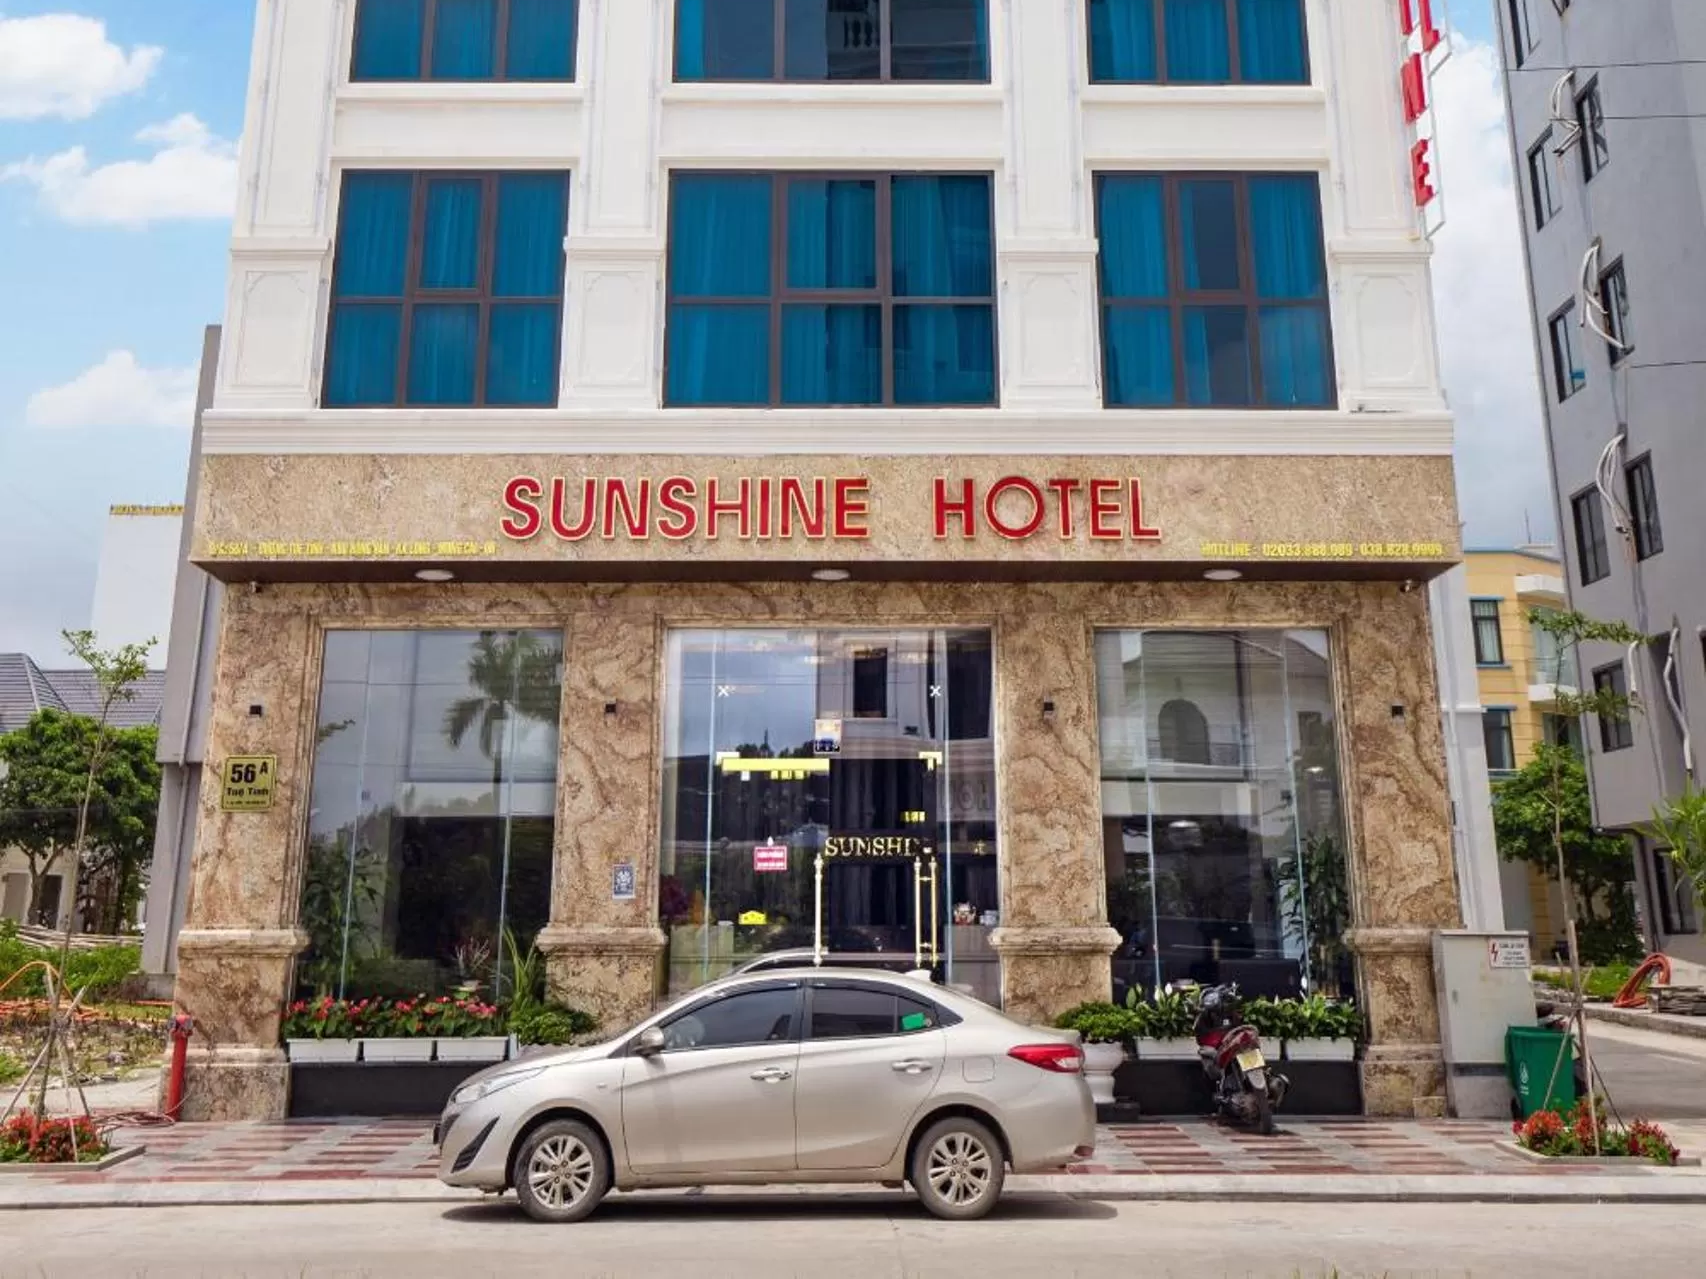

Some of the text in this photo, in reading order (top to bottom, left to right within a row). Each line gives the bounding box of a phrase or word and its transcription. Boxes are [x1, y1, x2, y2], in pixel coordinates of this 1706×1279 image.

[500, 475, 1162, 541] SUNSHINE HOTEL
[230, 763, 257, 784] 56
